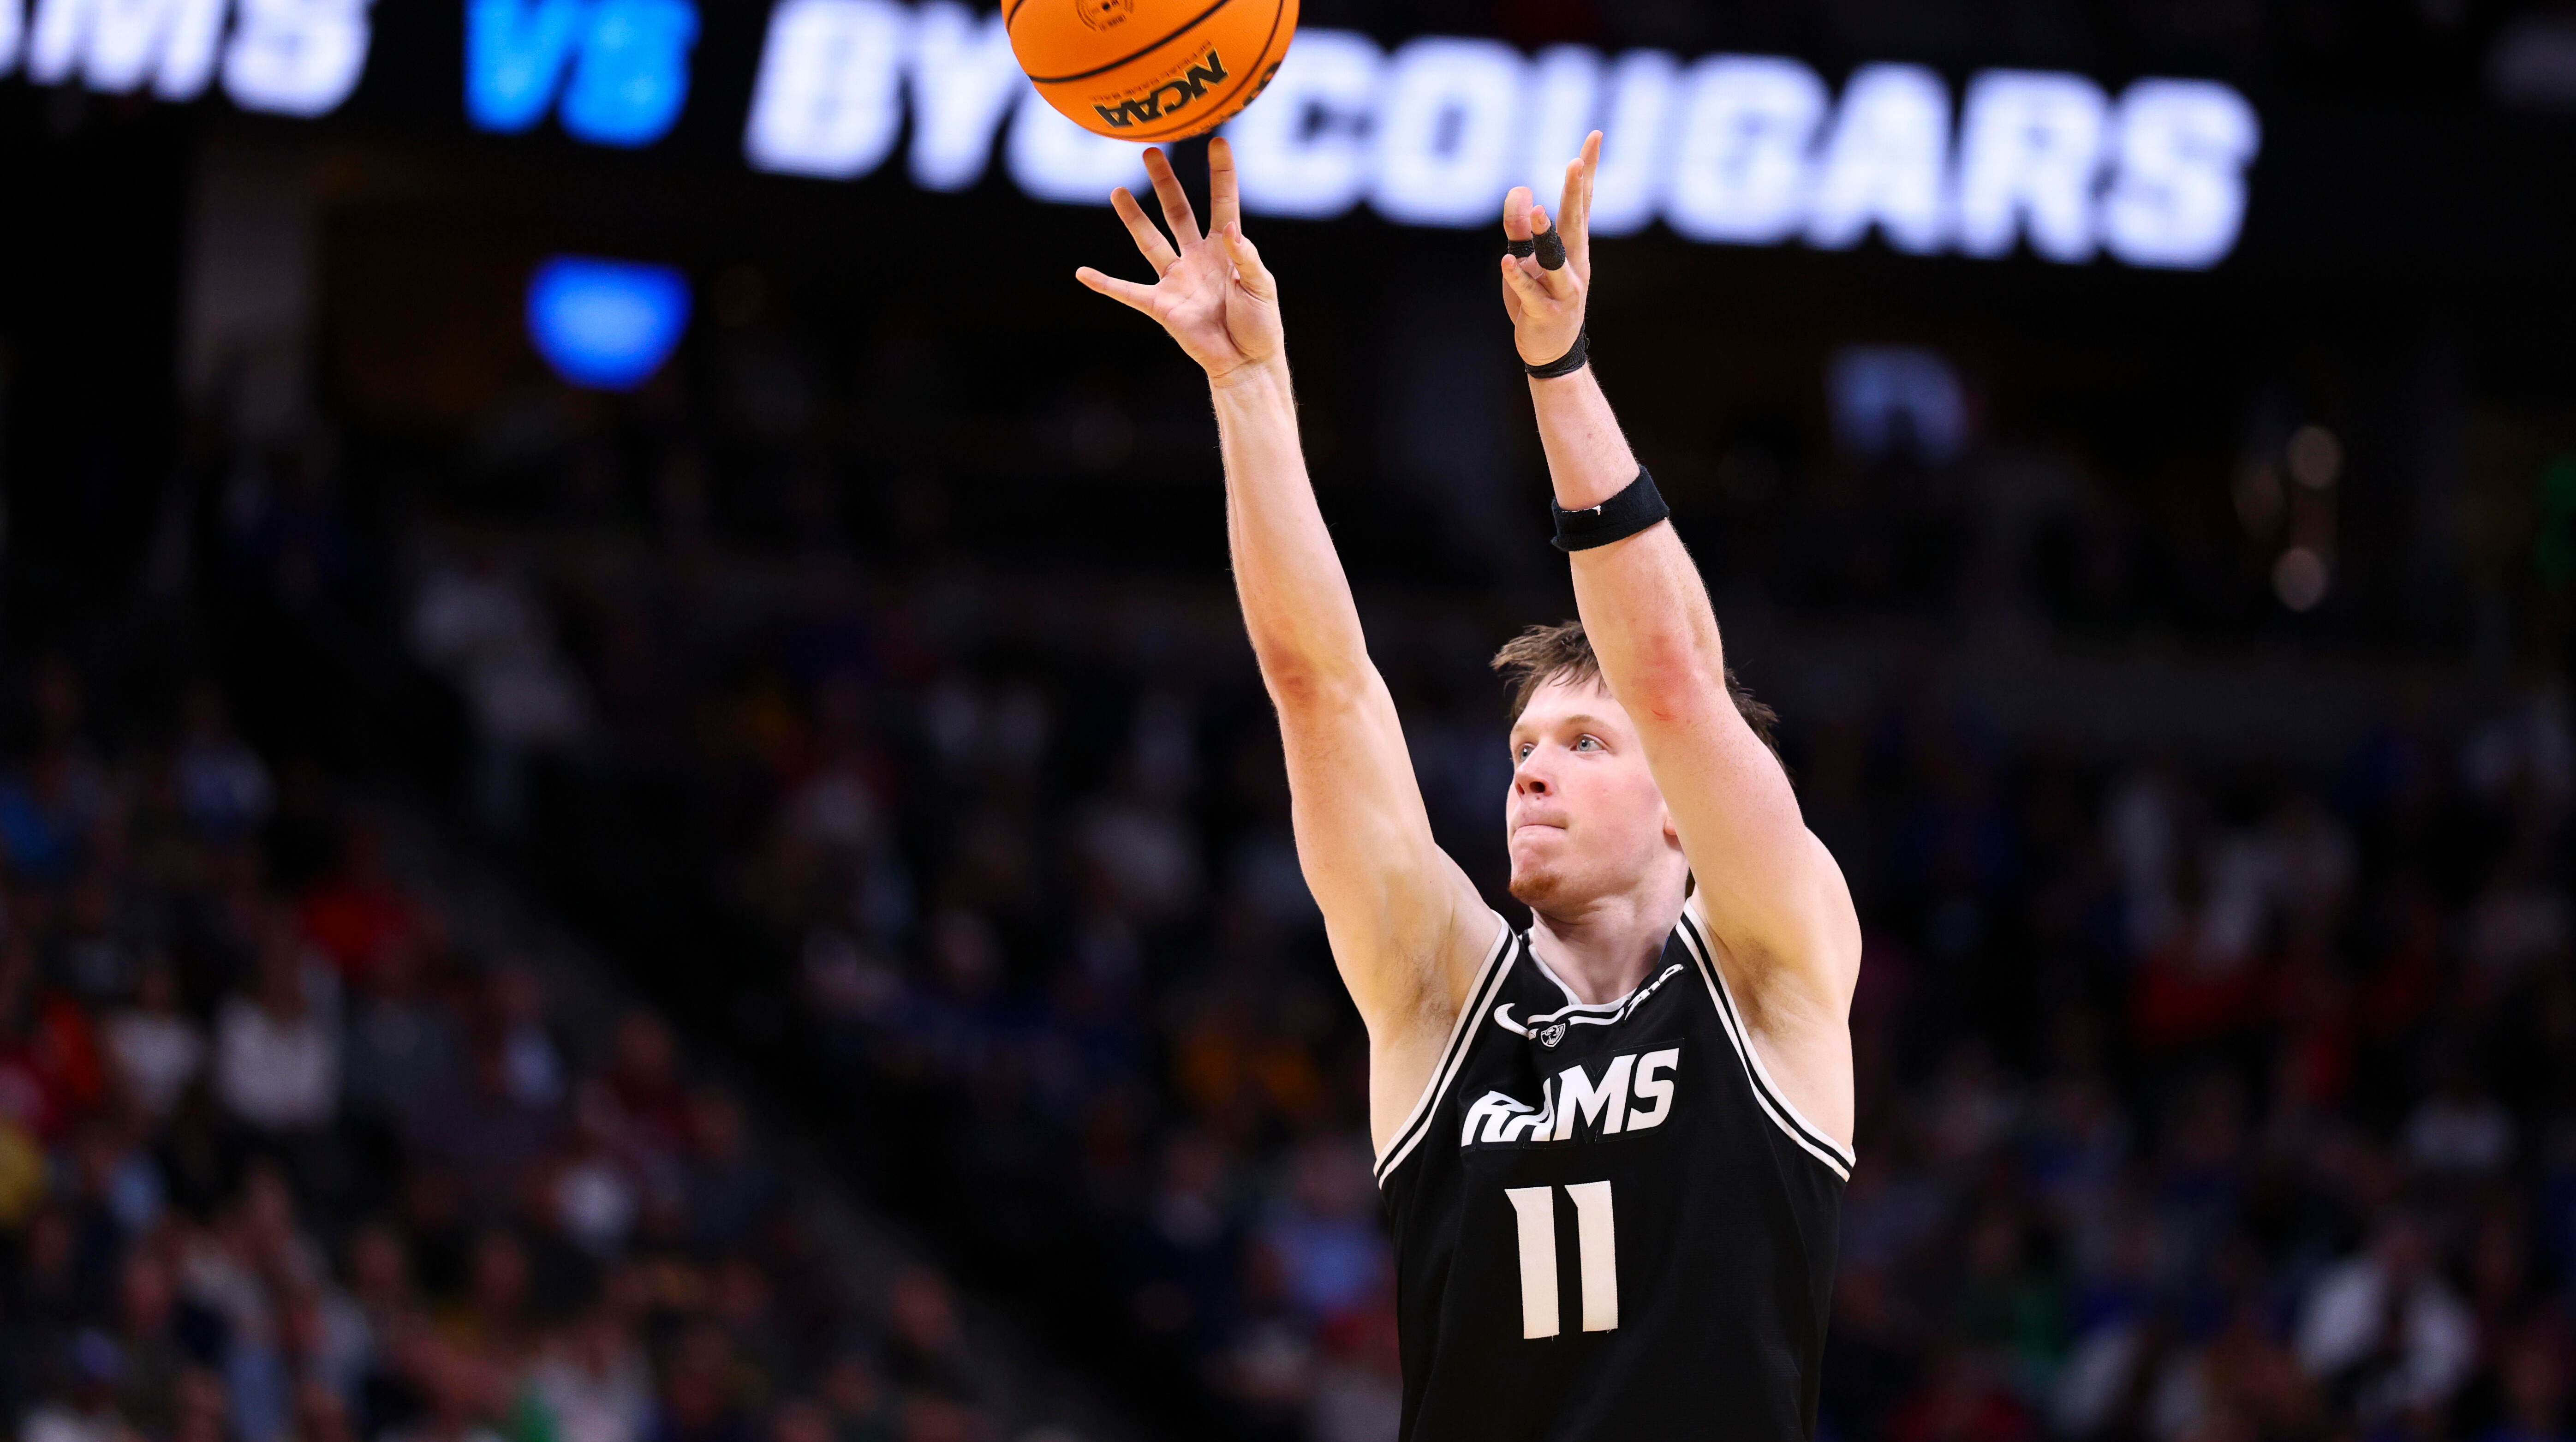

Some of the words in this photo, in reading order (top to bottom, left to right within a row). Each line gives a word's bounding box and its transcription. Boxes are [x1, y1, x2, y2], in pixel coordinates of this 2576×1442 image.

[464, 0, 700, 147] VS
[1228, 28, 2260, 271] COUGARS
[1091, 47, 1229, 127] NCAA
[1461, 1047, 1679, 1147] RAMS
[1504, 1180, 1618, 1339] 11
